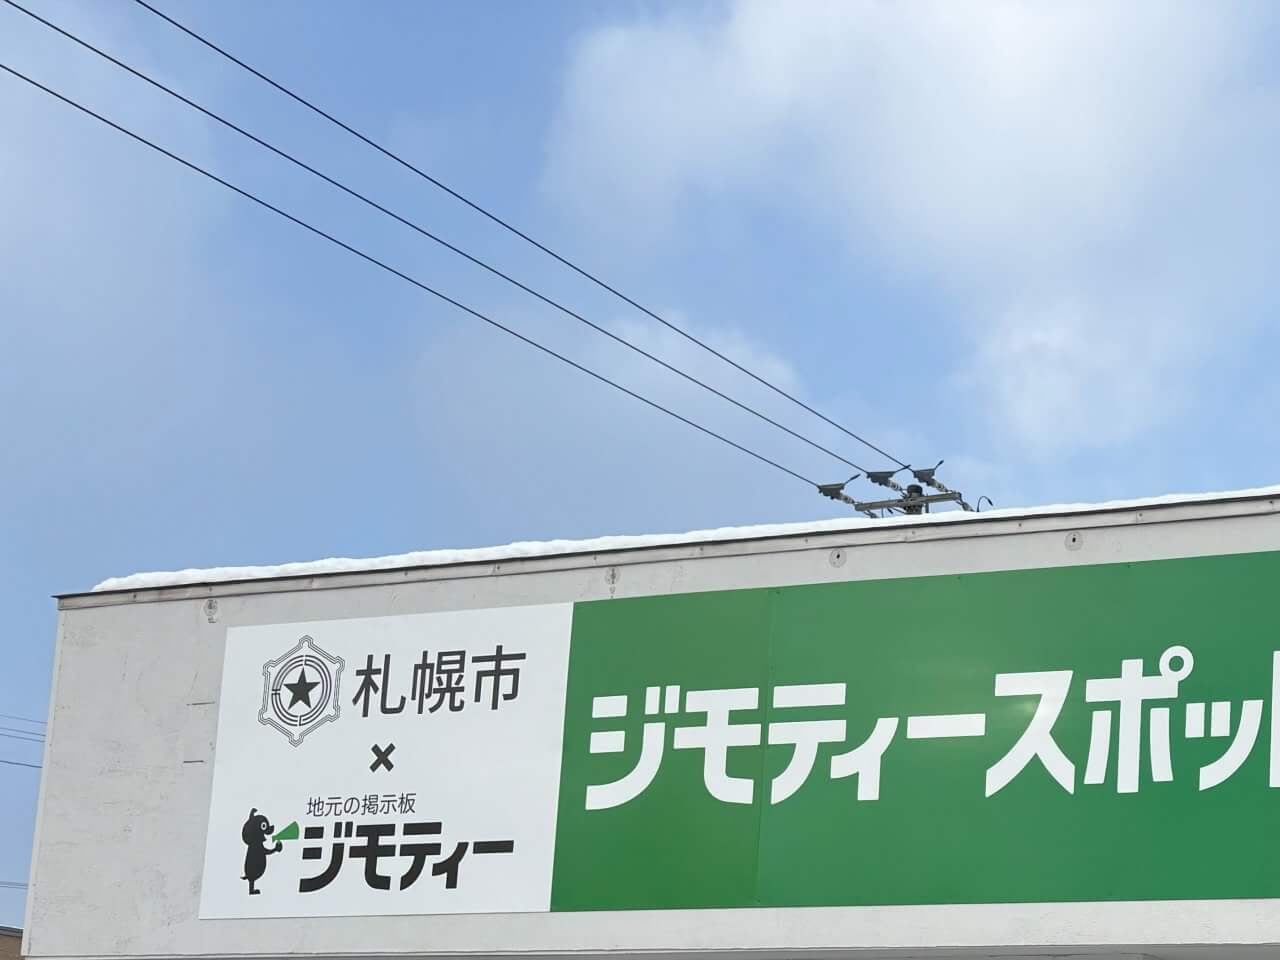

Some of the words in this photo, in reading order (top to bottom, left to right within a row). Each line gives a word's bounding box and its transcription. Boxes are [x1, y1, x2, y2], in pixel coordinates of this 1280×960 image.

[352, 645, 527, 718] 札幌市
[306, 793, 416, 817] 地元の掲示板
[299, 822, 514, 892] ジモティー
